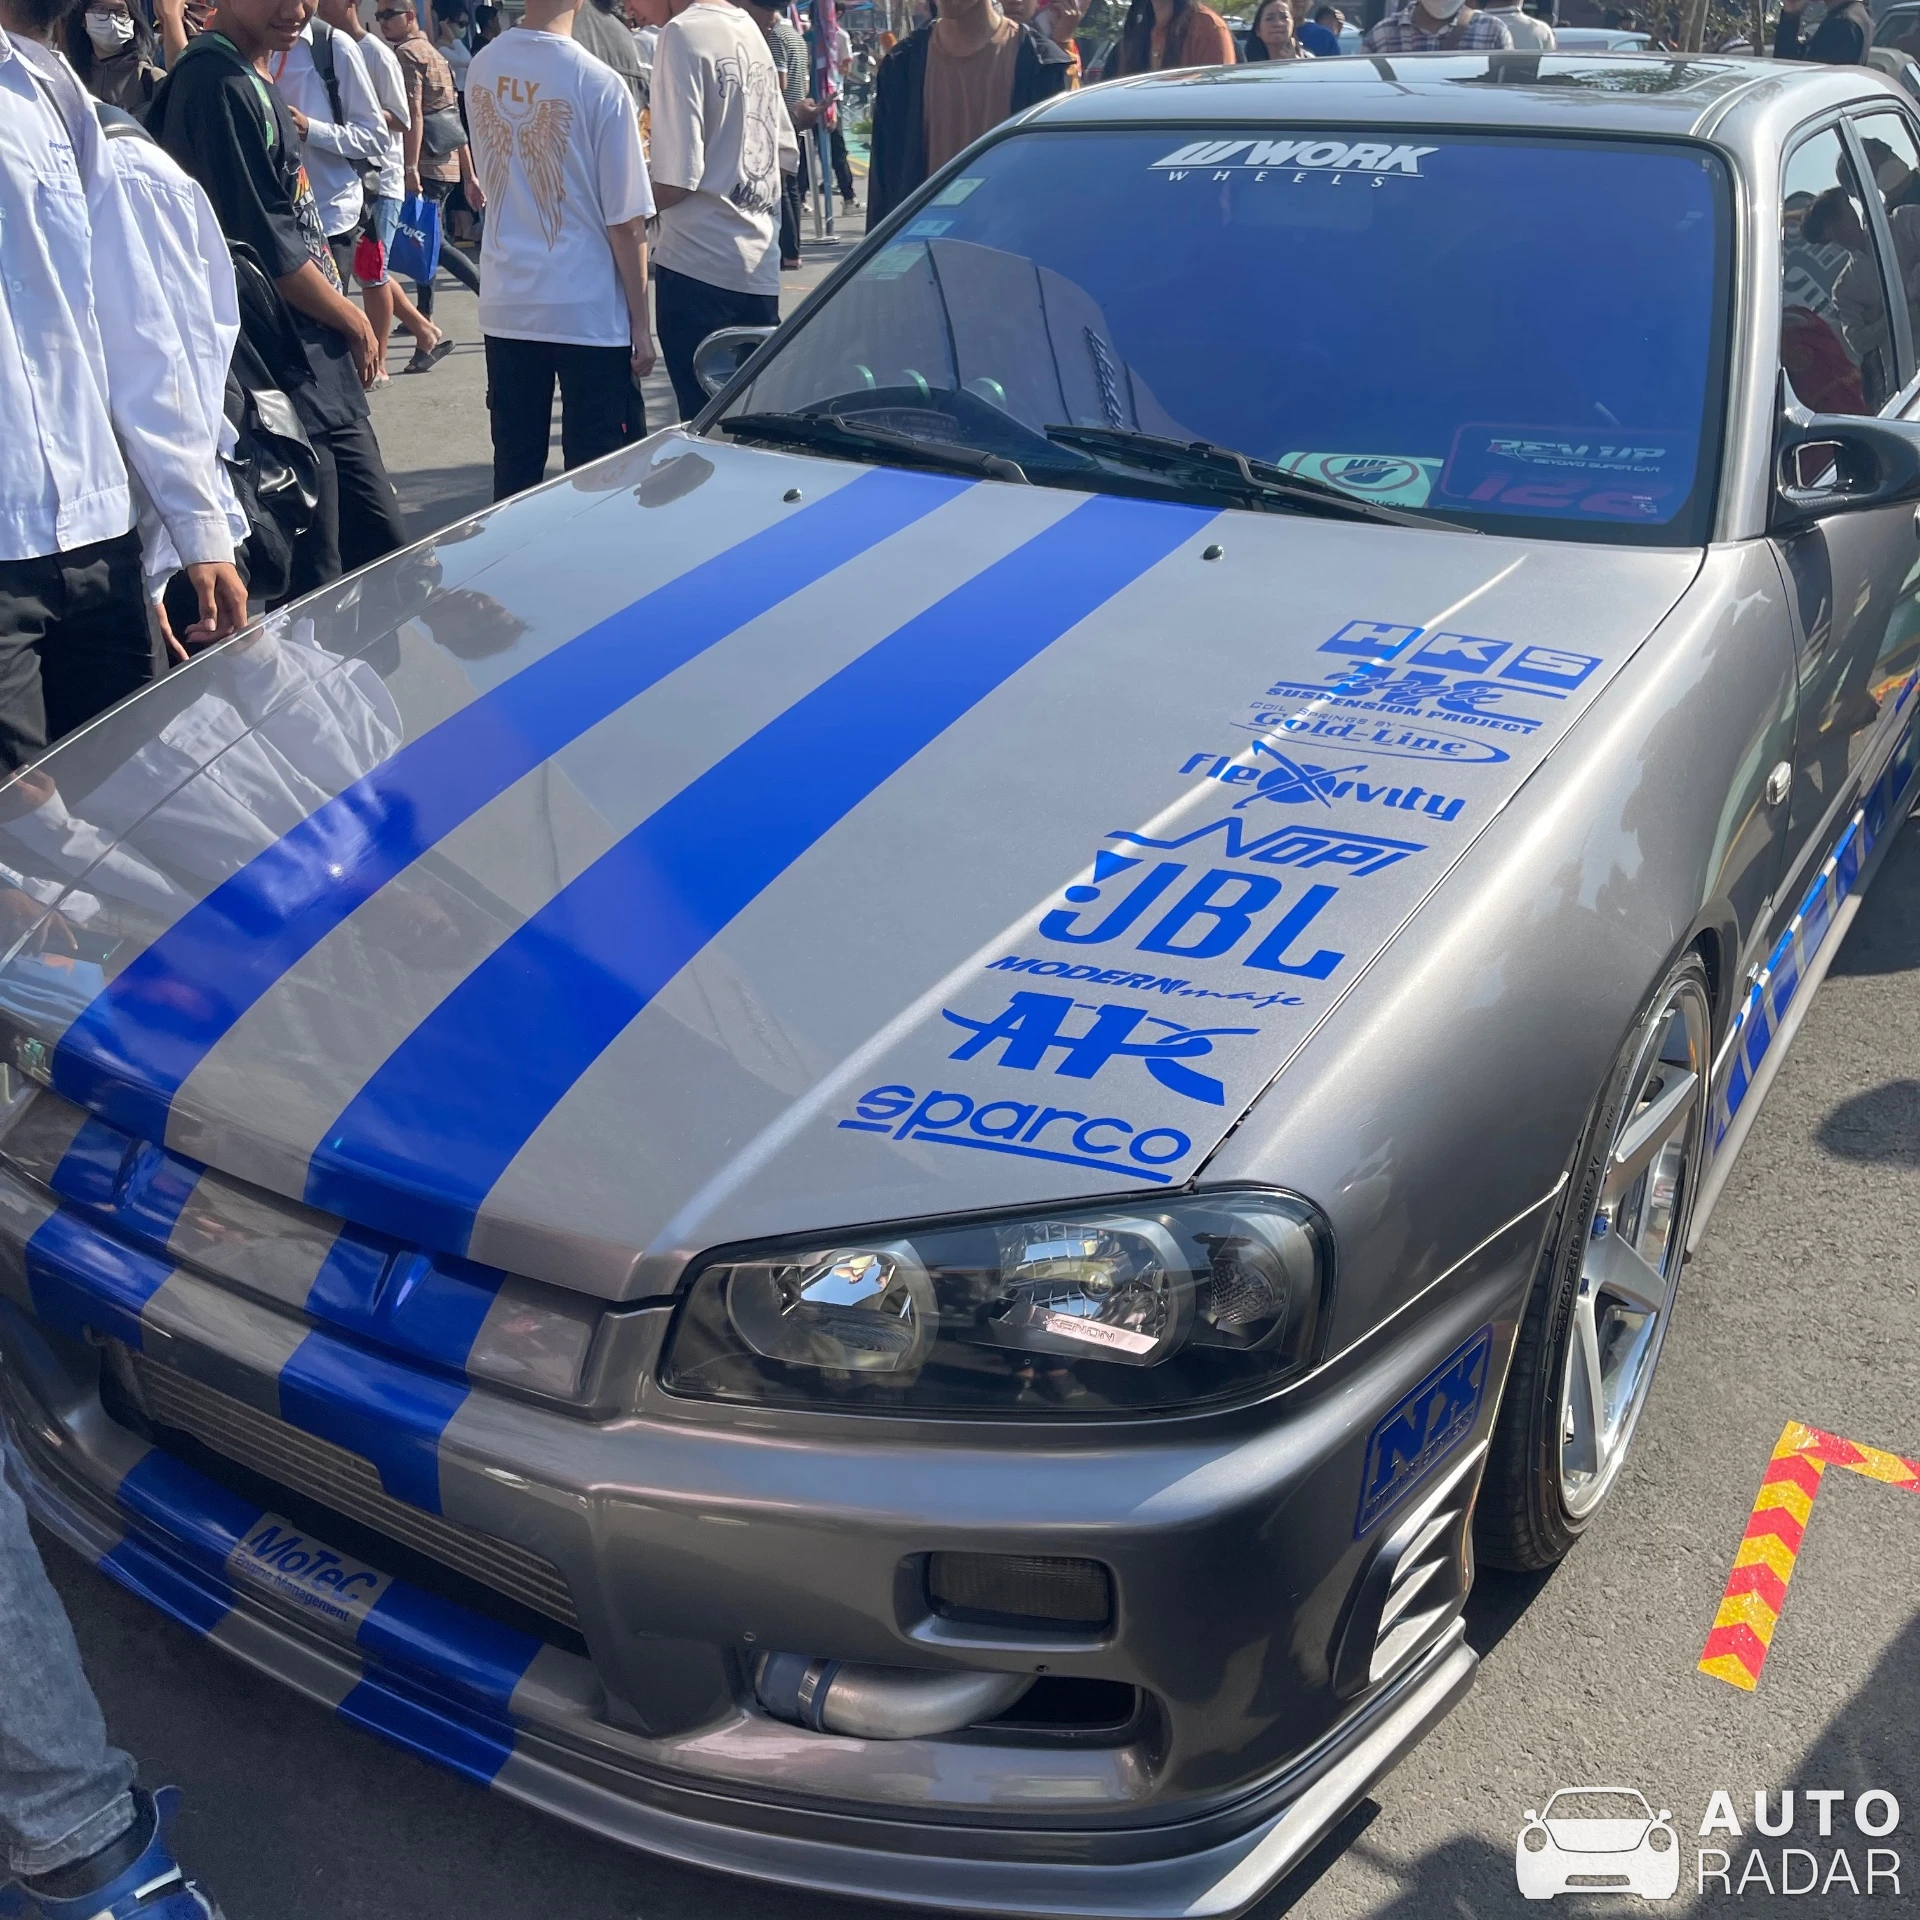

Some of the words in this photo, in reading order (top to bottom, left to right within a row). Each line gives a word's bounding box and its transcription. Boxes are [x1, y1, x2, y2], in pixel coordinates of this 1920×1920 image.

[497, 75, 540, 104] FLY
[1168, 170, 1386, 189] WHEELS
[1244, 140, 1440, 174] WORK
[1532, 458, 1586, 467] BEYOND
[1588, 462, 1632, 471] SUPER
[1633, 465, 1661, 473] CAR
[1316, 619, 1604, 691] HKS
[1249, 700, 1287, 713] COIL
[1296, 706, 1370, 726] SPRINGS
[1374, 719, 1397, 729] BY
[1249, 710, 1469, 757] Gold-Line
[1265, 686, 1425, 717] SUSPENSION
[1425, 709, 1539, 735] PROJECT
[1104, 816, 1429, 877] NOPI
[1037, 861, 1346, 981] JBL
[855, 1083, 1193, 1167] sparco
[1043, 1316, 1116, 1343] XENON
[1368, 1336, 1488, 1502] NX
[235, 1553, 275, 1582] Engine
[275, 1576, 350, 1622] Management
[249, 1525, 378, 1603] MoTeC
